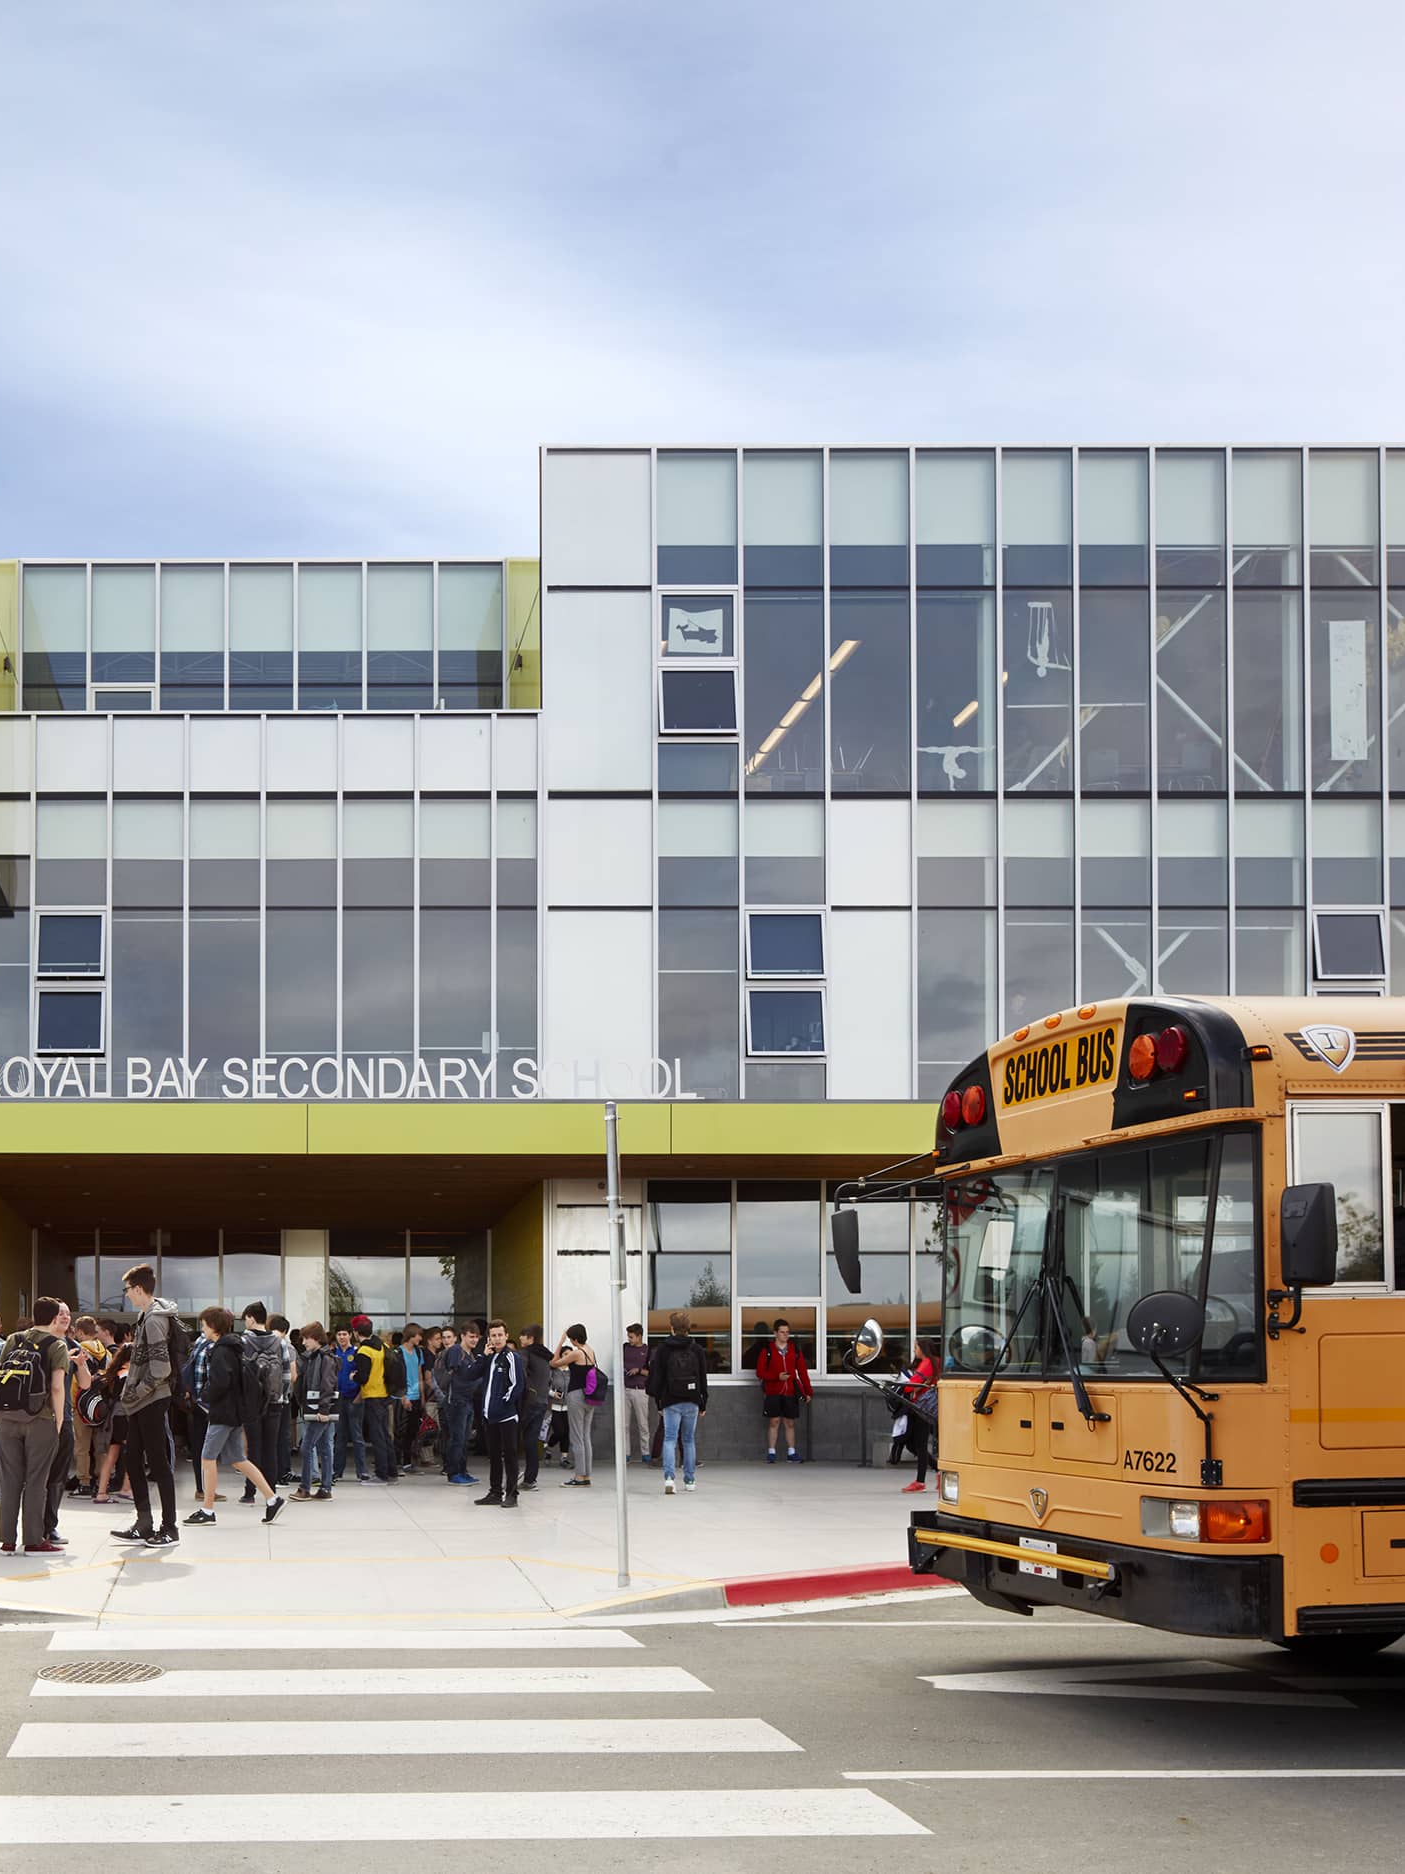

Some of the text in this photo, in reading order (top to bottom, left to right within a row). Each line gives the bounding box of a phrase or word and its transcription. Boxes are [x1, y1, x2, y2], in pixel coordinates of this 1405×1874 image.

[127, 1057, 208, 1098] BAY
[222, 1057, 497, 1098] SECONDARY
[511, 1057, 698, 1098] SCHOOL
[1004, 1028, 1115, 1105] SCHOOL BUS
[1123, 1450, 1177, 1473] A7622
